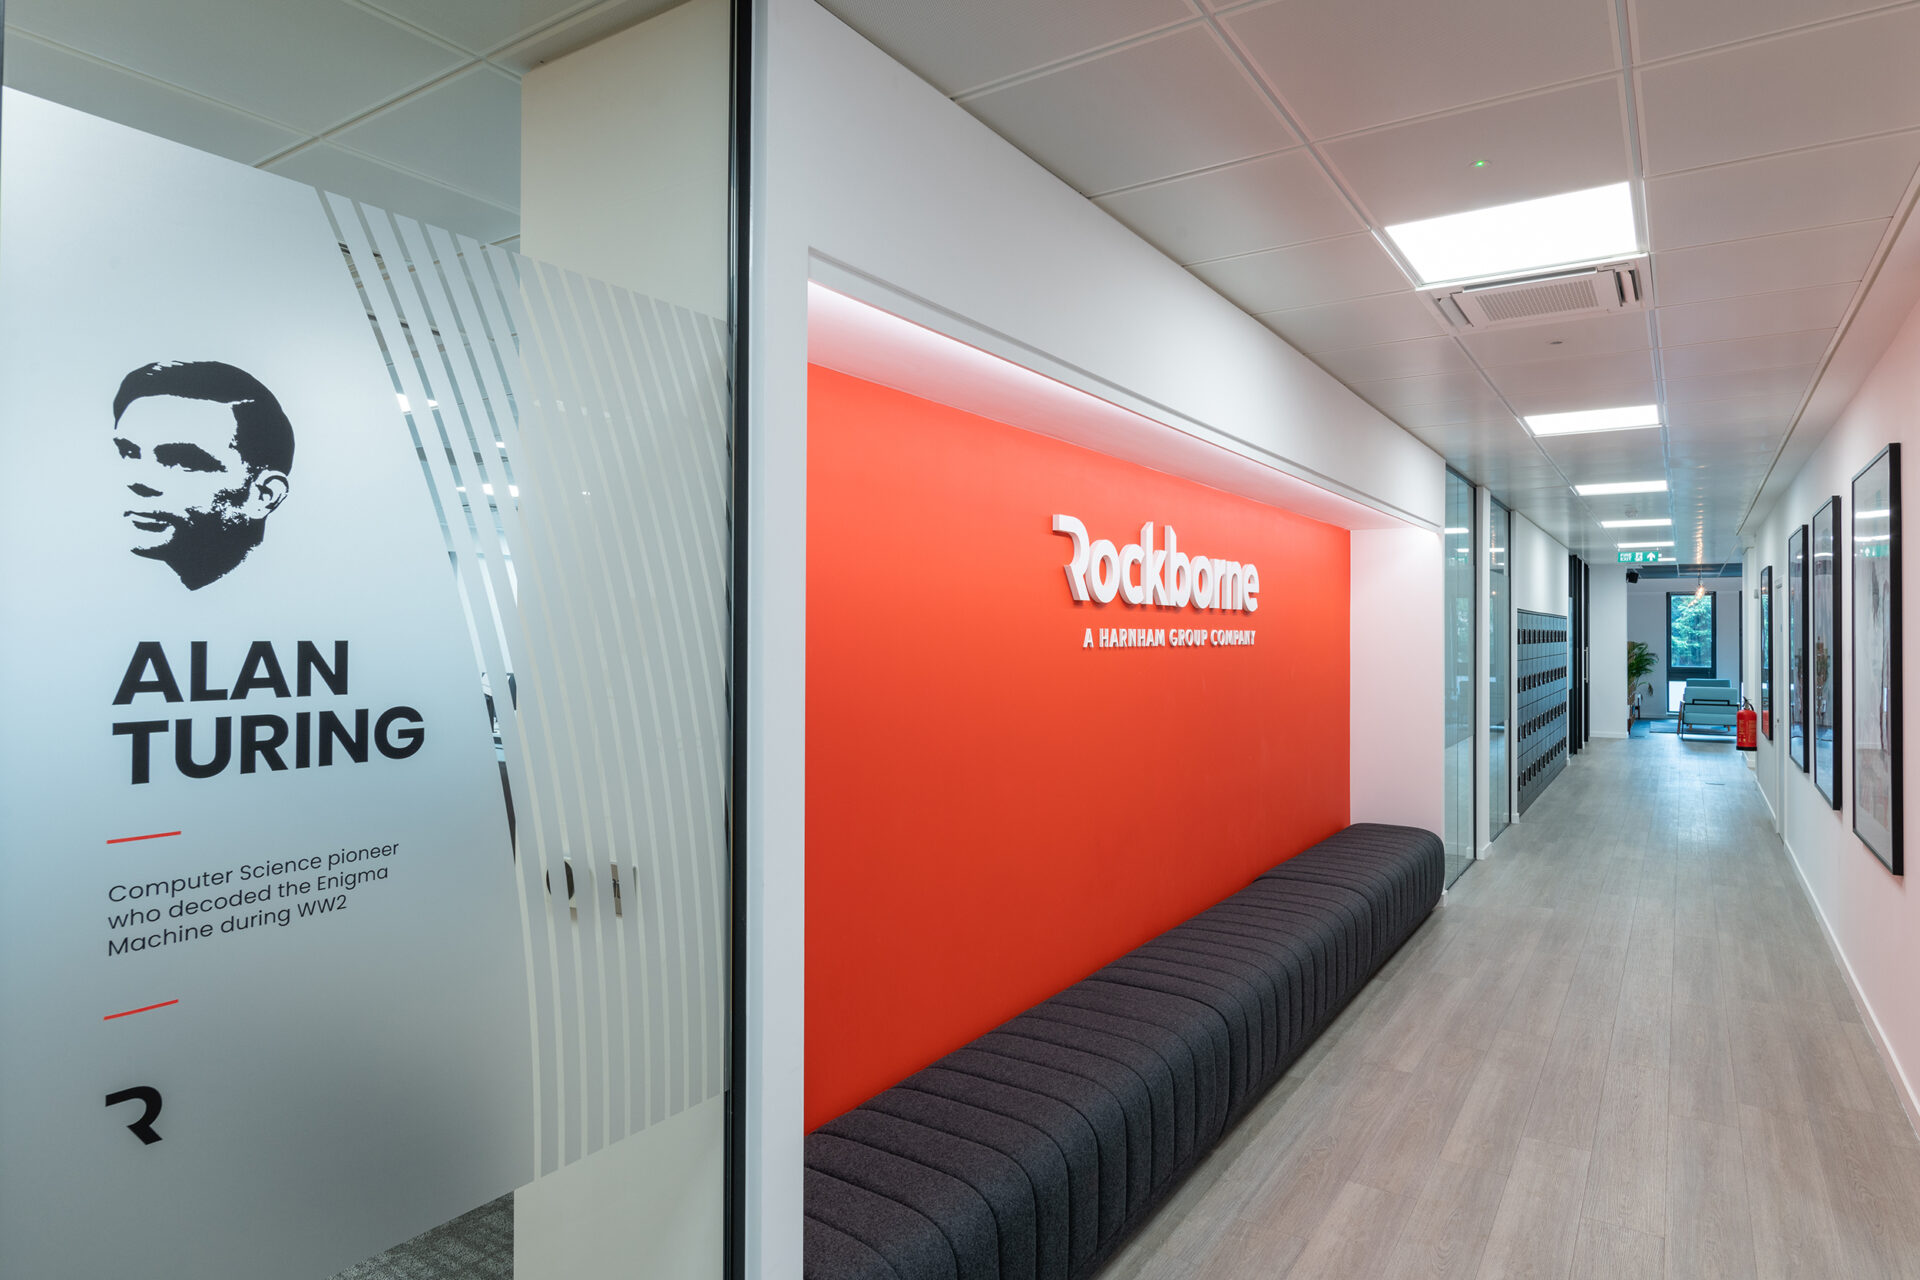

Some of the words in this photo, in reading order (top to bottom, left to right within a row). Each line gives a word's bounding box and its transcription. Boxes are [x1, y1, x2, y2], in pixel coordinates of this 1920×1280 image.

[1052, 514, 1259, 612] Rockborne
[1083, 628, 1094, 648] A
[1099, 628, 1166, 648] HARNHAM
[1169, 628, 1208, 647] GROUP
[1210, 629, 1256, 646] COMPANY
[112, 640, 349, 705] ALAN
[112, 706, 425, 785] TURING
[108, 870, 233, 902] Computer
[240, 856, 322, 880] Science
[328, 843, 399, 871] pioneer
[108, 908, 161, 929] who
[169, 885, 271, 918] decoded
[278, 881, 311, 898] the
[317, 867, 388, 890] Enigma
[108, 924, 213, 956] Machine
[220, 908, 290, 933] during
[297, 894, 347, 917] WW2
